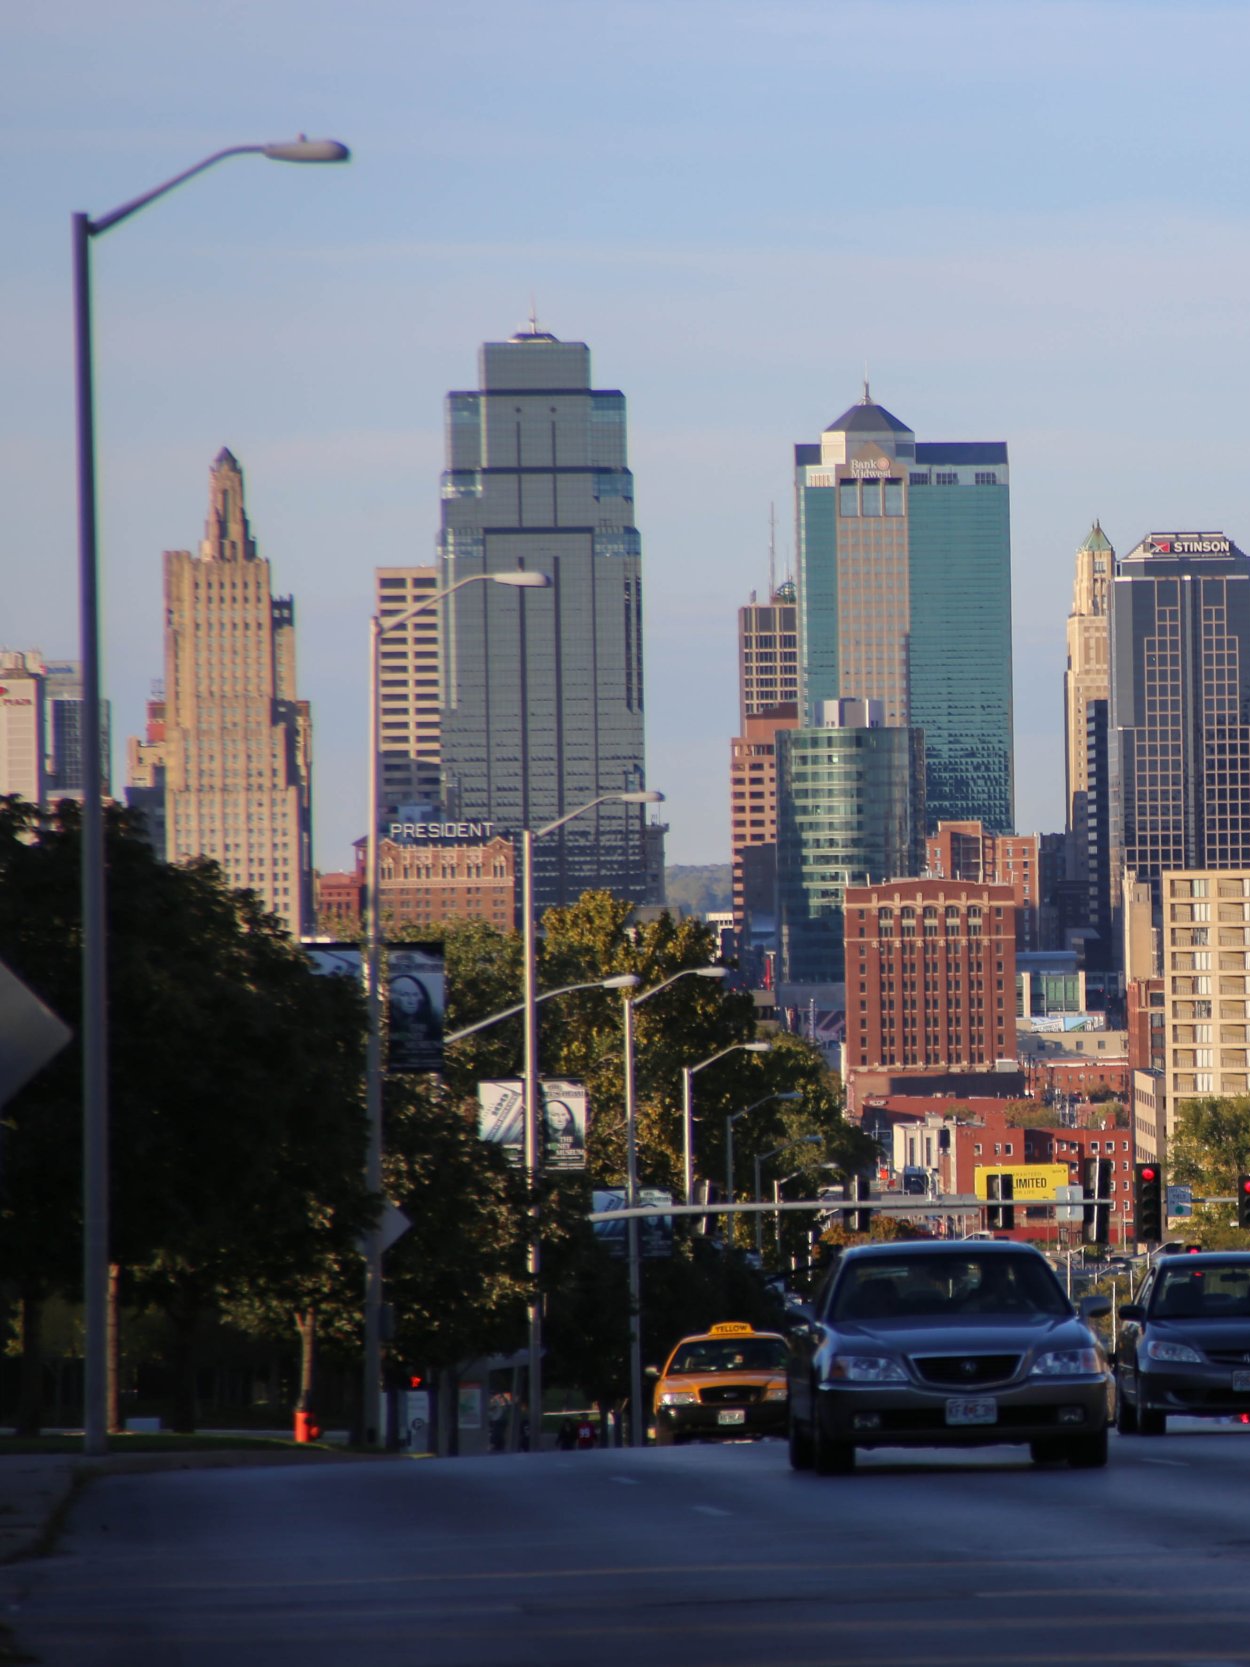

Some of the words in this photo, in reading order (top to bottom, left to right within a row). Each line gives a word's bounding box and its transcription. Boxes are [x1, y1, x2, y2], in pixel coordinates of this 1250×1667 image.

[851, 459, 877, 469] Bank
[851, 468, 892, 478] Midwest
[1174, 541, 1230, 552] STINSON
[390, 822, 494, 838] PRESIDENT
[1012, 1177, 1047, 1189] IMITED
[715, 1325, 748, 1333] YELLOW
